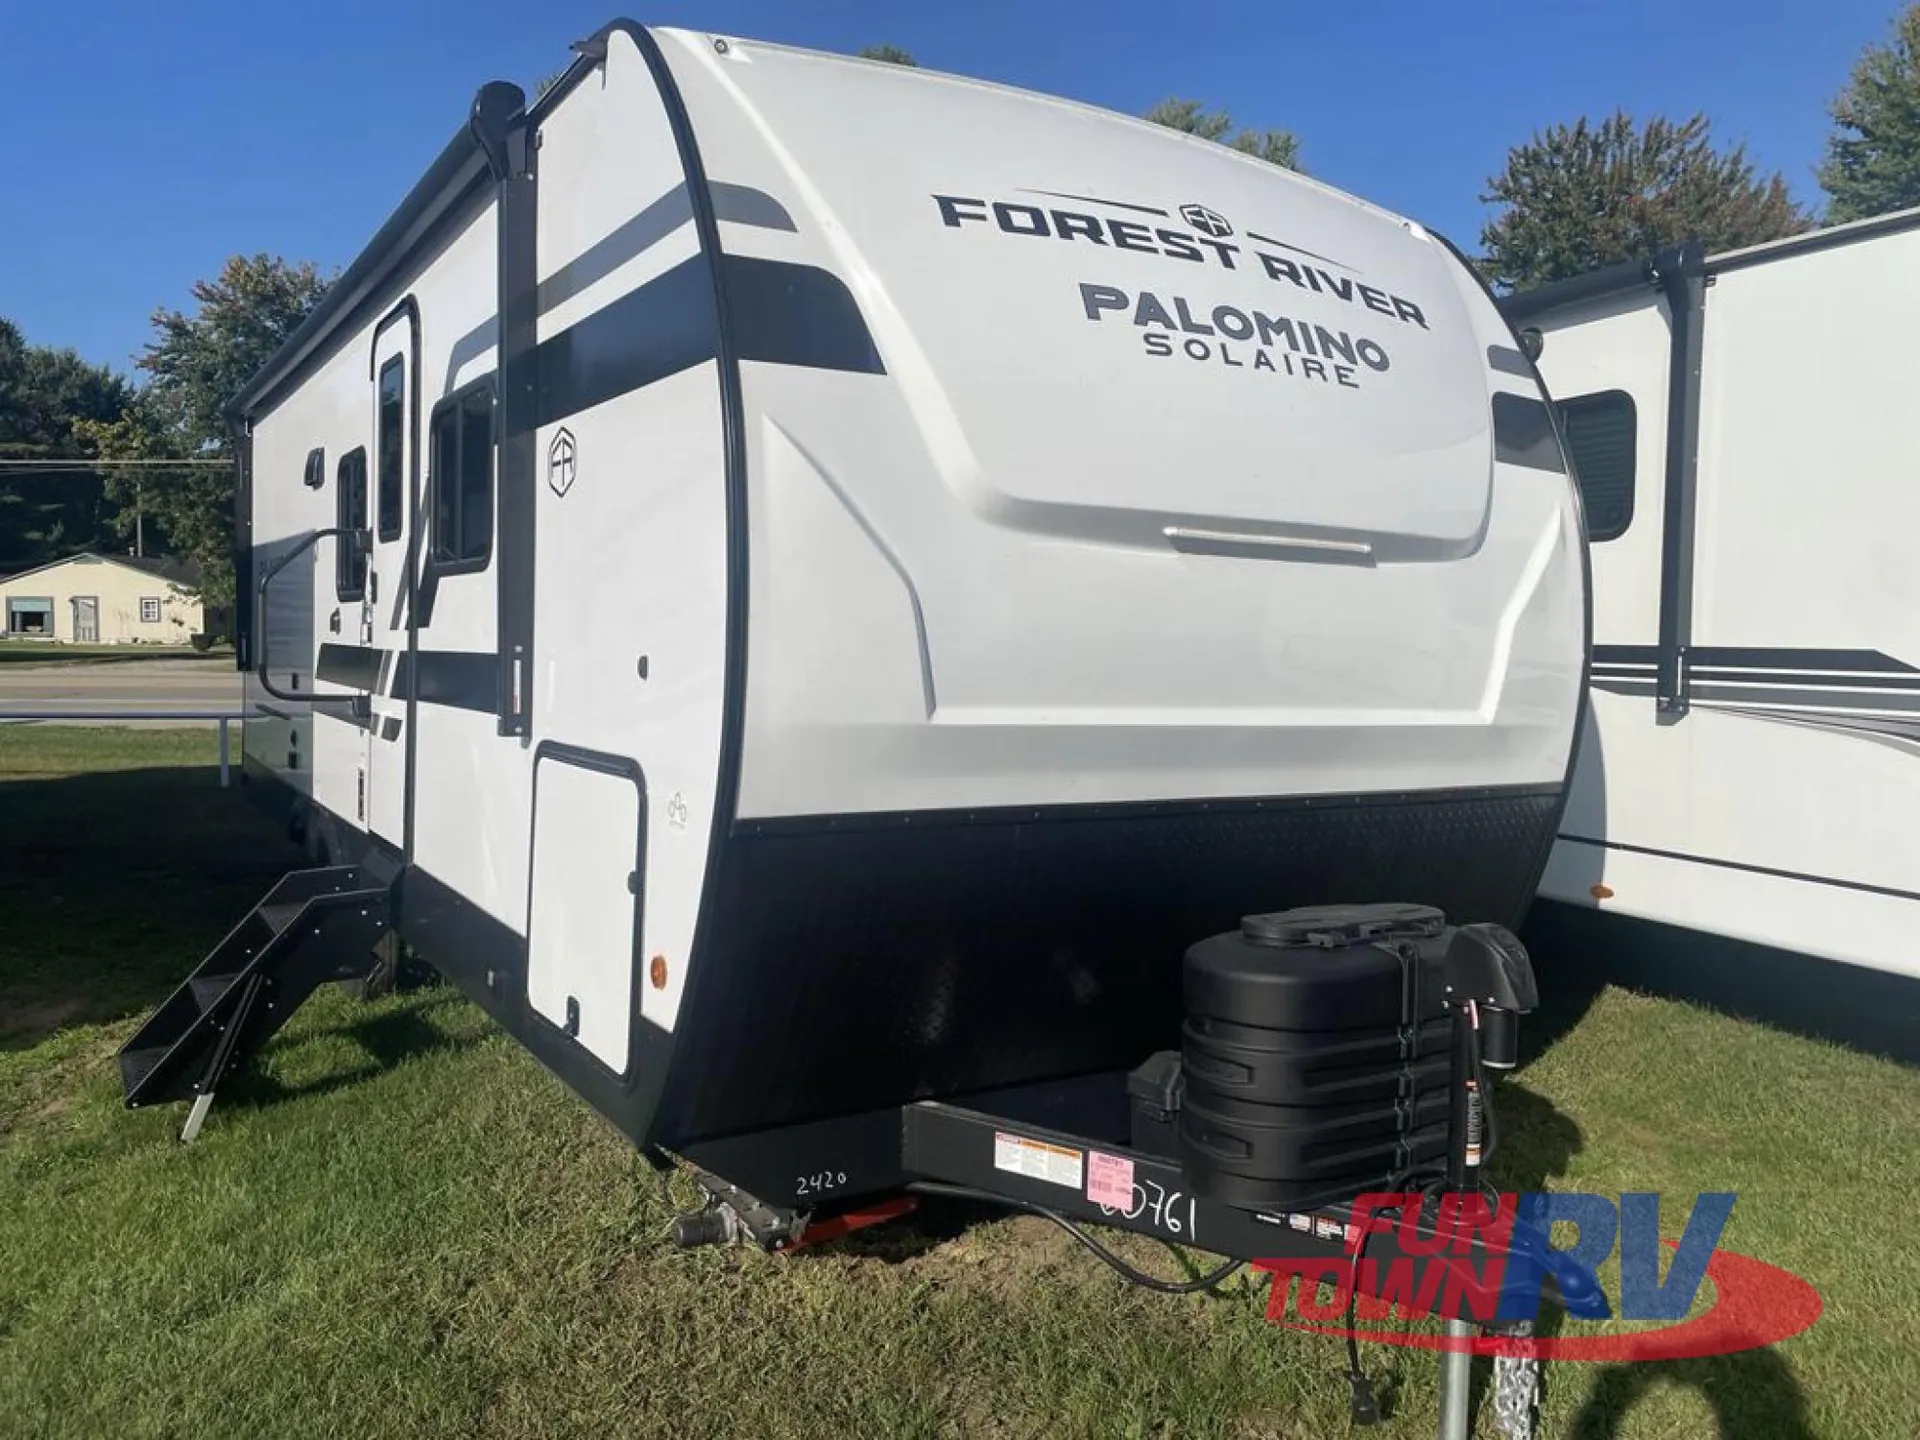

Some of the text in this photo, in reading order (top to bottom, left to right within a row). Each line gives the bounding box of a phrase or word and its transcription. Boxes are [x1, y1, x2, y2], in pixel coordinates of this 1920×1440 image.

[932, 195, 1430, 330] FOREST RIVER
[1079, 282, 1390, 372] PALOMINO
[1143, 333, 1360, 388] SOLAIRE
[796, 1171, 847, 1194] 2420
